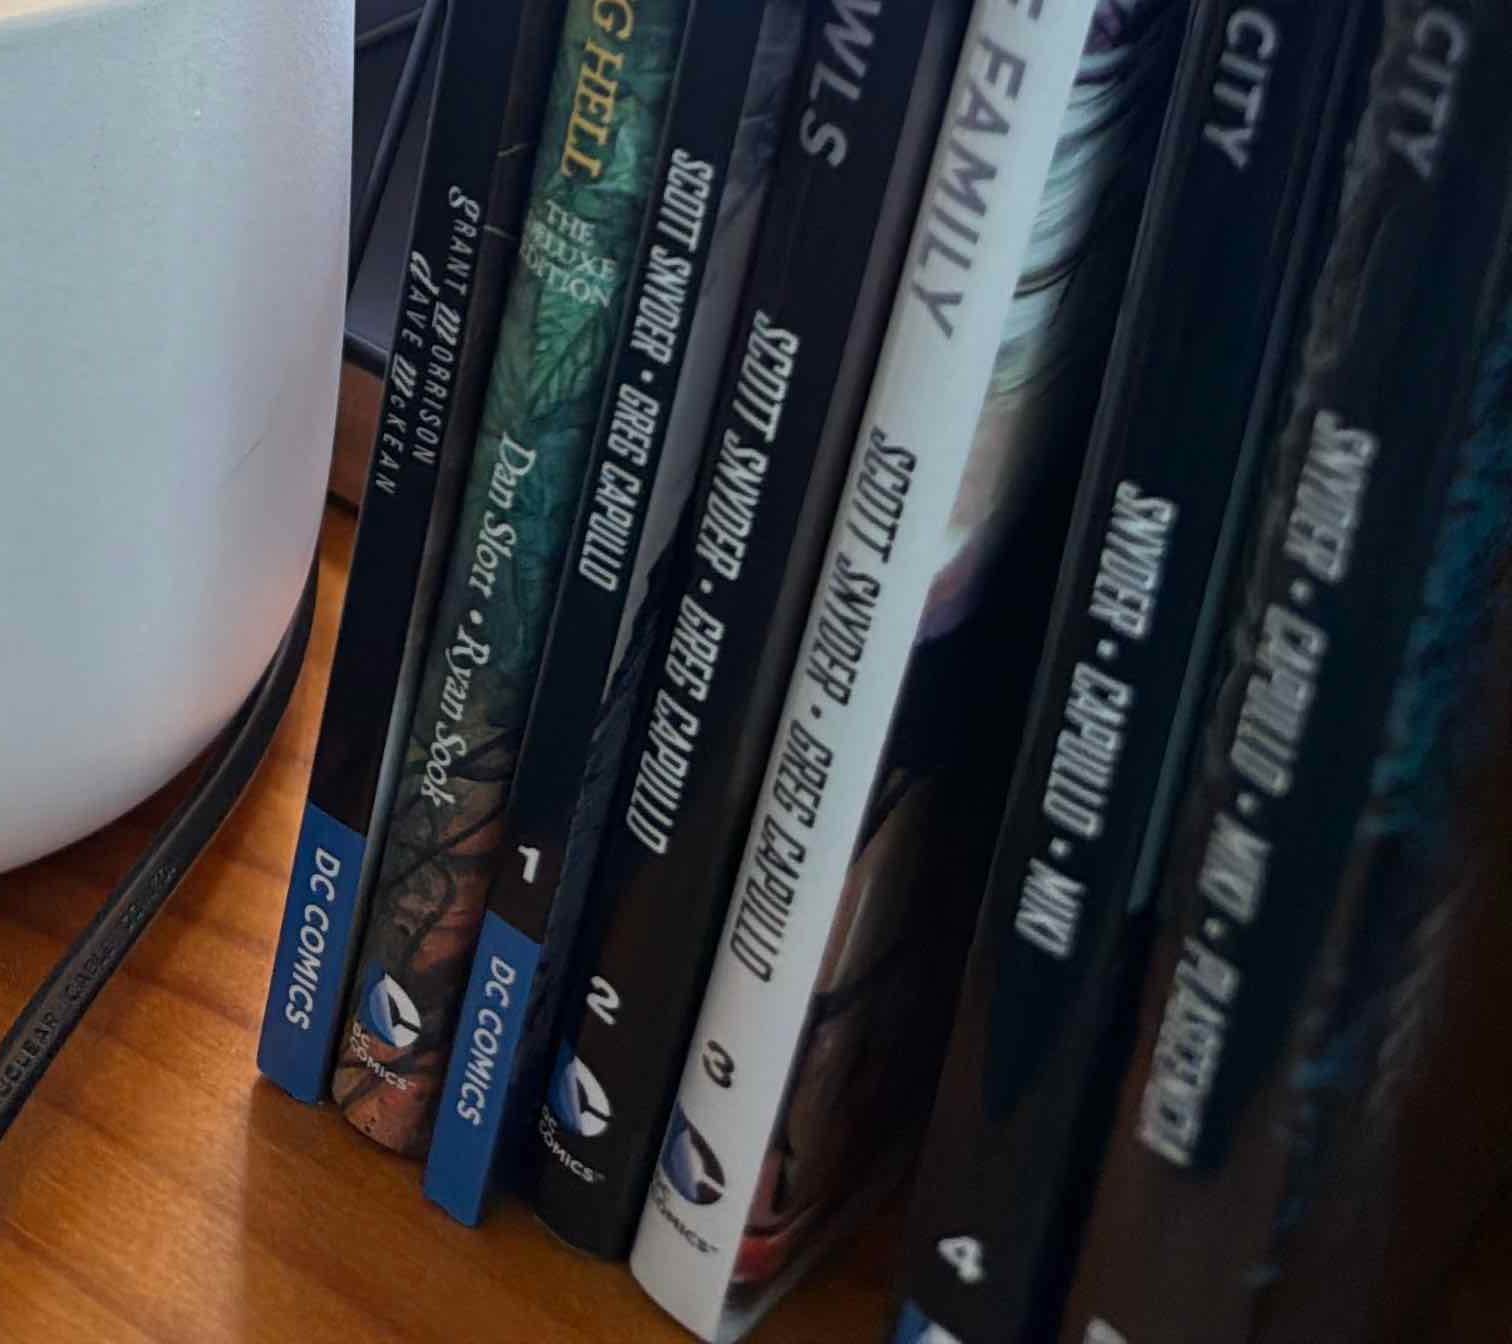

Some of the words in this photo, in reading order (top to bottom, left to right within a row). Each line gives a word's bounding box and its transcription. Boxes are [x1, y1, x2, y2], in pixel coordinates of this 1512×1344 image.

[560, 38, 626, 184] HELL
[1202, 8, 1278, 171] CITY
[1389, 14, 1470, 180] CITY
[658, 146, 715, 252] SCOTT
[909, 34, 1028, 341] FAMILY
[628, 240, 700, 367] SNYDER
[606, 382, 661, 482] GREG
[729, 309, 800, 443] SCOTT
[488, 431, 537, 511] Dan
[578, 459, 643, 593] CAPULLO
[695, 429, 771, 583] SNYDER
[843, 423, 918, 565] SCOTT
[1283, 408, 1380, 586] SNYDER
[1088, 479, 1179, 641] SNYDER
[439, 623, 491, 722] Ryan
[662, 593, 727, 704] GREG
[806, 550, 884, 709] SNYDER
[420, 720, 469, 809] Sook
[1042, 660, 1134, 840] CAPULLO
[1228, 603, 1330, 799] CAPULLO
[625, 688, 701, 856] CAPULLO
[770, 717, 835, 831] GREG
[314, 845, 342, 900] DC
[517, 845, 541, 886] 1
[728, 813, 807, 984] CAPULLO
[285, 904, 332, 1032] COMICS
[488, 955, 518, 1010] DC
[586, 975, 622, 1026] 2
[455, 1009, 509, 1128] COMICS
[701, 1039, 737, 1090] 3
[936, 1234, 986, 1286] 4
